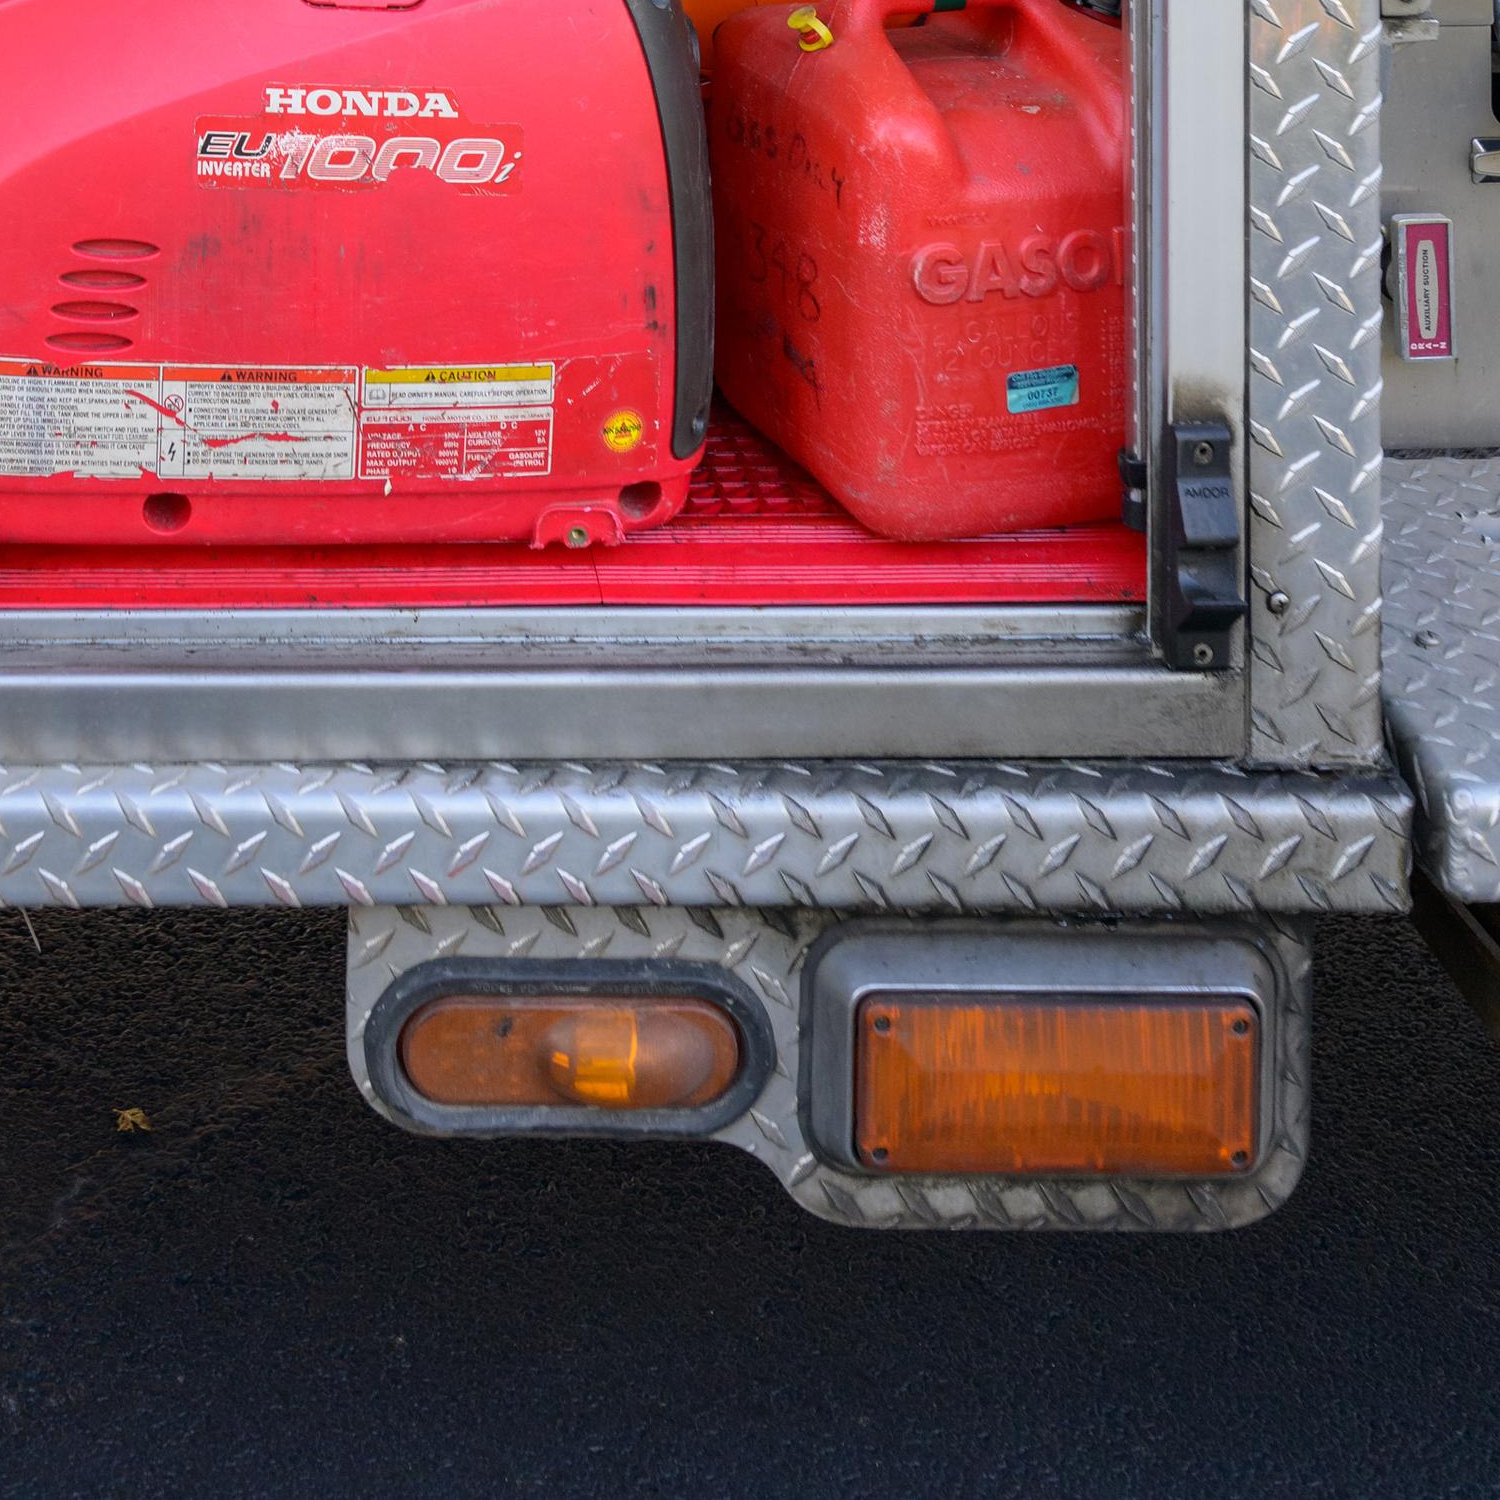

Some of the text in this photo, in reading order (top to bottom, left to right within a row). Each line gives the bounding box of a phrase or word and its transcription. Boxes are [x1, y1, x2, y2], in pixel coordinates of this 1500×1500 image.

[265, 88, 459, 118] HONDA
[197, 160, 271, 178] INVERTER
[1422, 249, 1432, 332] AUXILIARY SUCTION
[41, 365, 103, 378] WARNING
[236, 371, 297, 382] WARNING
[439, 369, 497, 382] CAUTION
[366, 450, 391, 458] RATED
[387, 459, 417, 467] OUTPUT
[366, 467, 390, 475] PHASE
[1185, 487, 1230, 499] AMDOR
